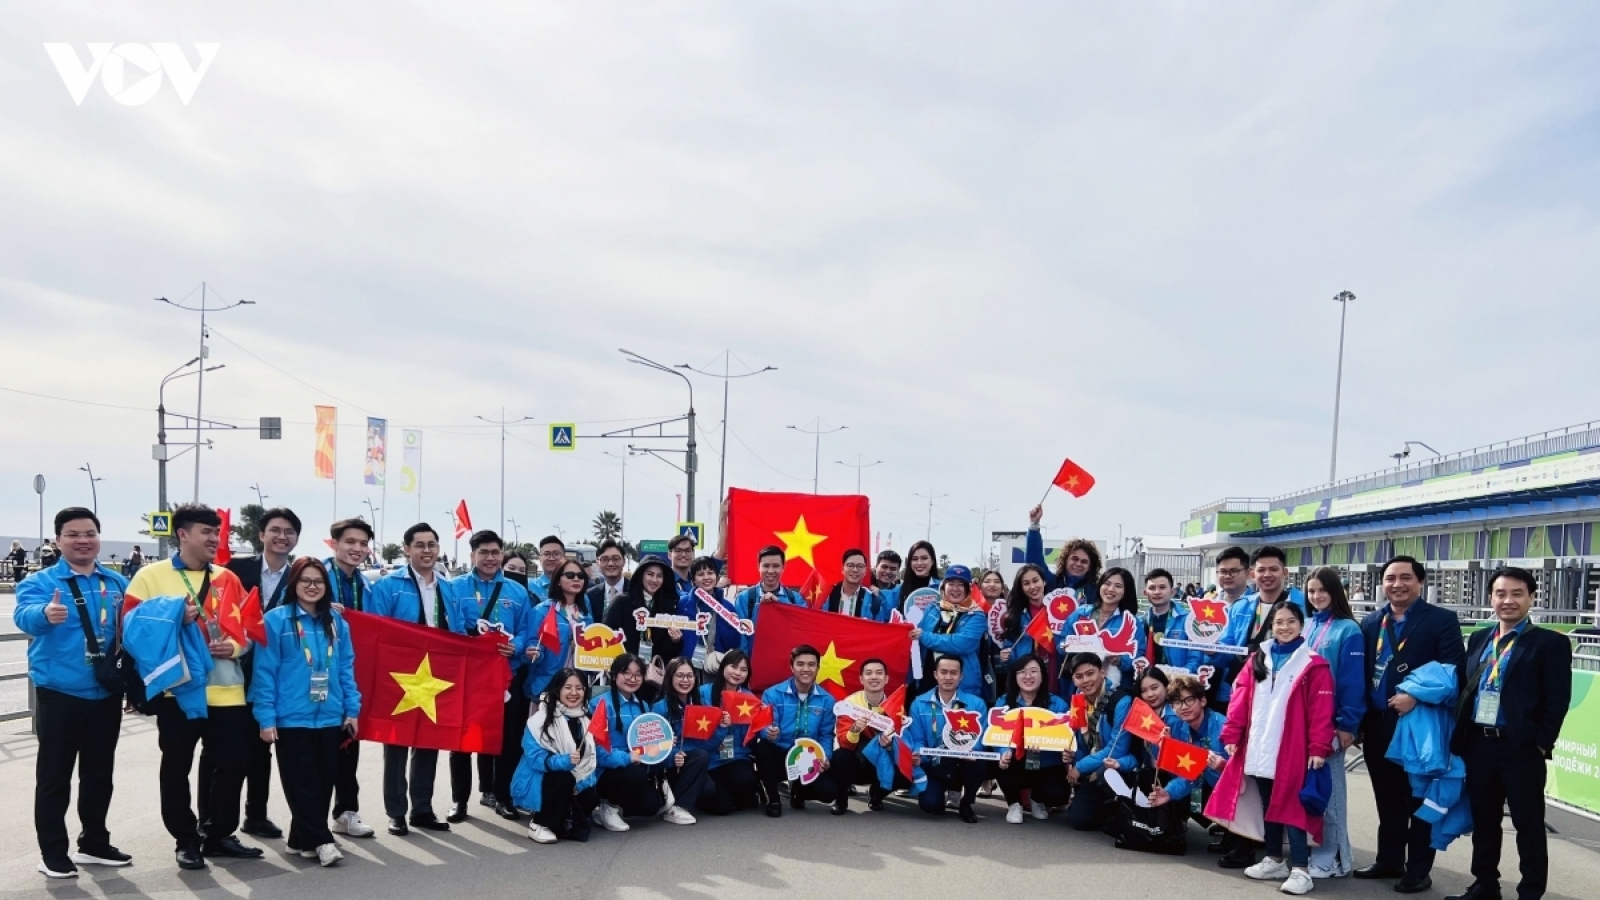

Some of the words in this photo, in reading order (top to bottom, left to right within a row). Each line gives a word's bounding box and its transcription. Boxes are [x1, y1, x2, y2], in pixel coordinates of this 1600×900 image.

[991, 733, 1010, 741] RISI
[1027, 736, 1069, 745] VIETNAM
[1553, 739, 1597, 759] ЕМИРНЫЙ
[1552, 755, 1592, 776] ЛОДЁЖИ
